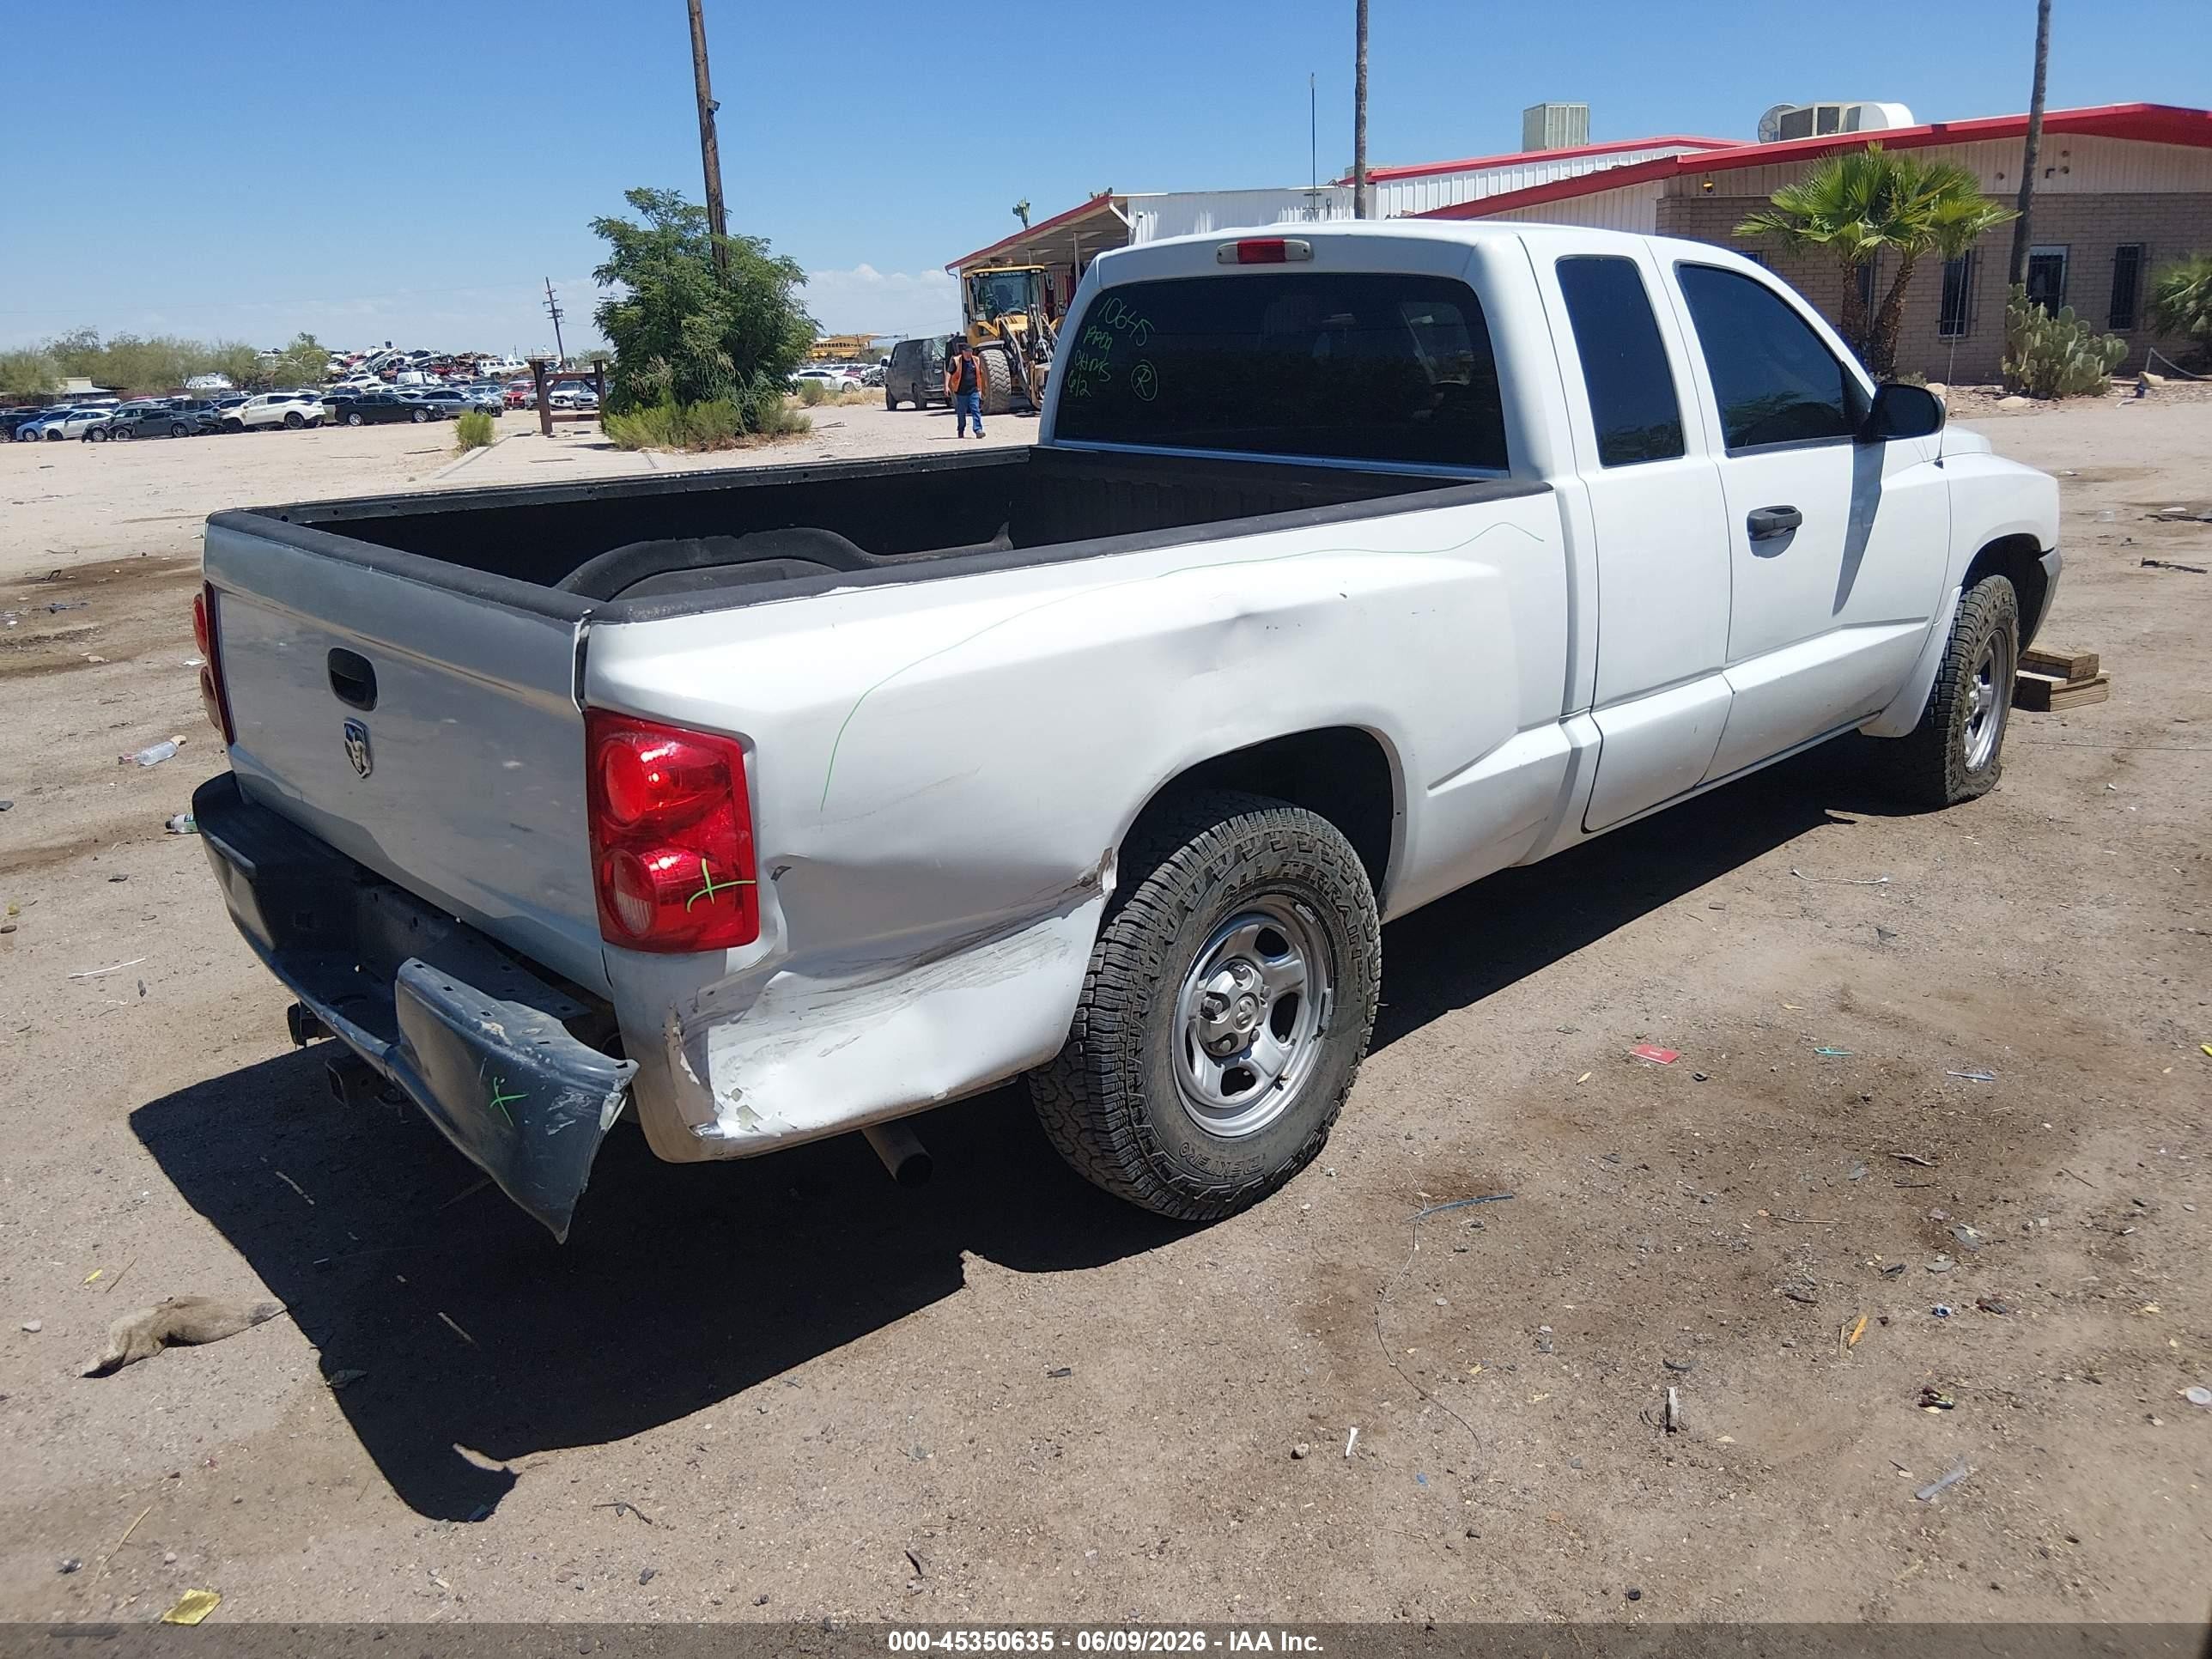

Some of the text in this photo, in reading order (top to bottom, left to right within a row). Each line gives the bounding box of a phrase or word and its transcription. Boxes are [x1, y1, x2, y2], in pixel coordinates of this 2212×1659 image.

[1216, 865, 1270, 910] ALL
[1279, 860, 1363, 960] TERRAIN
[1178, 1141, 1267, 1178] DEXTERO
